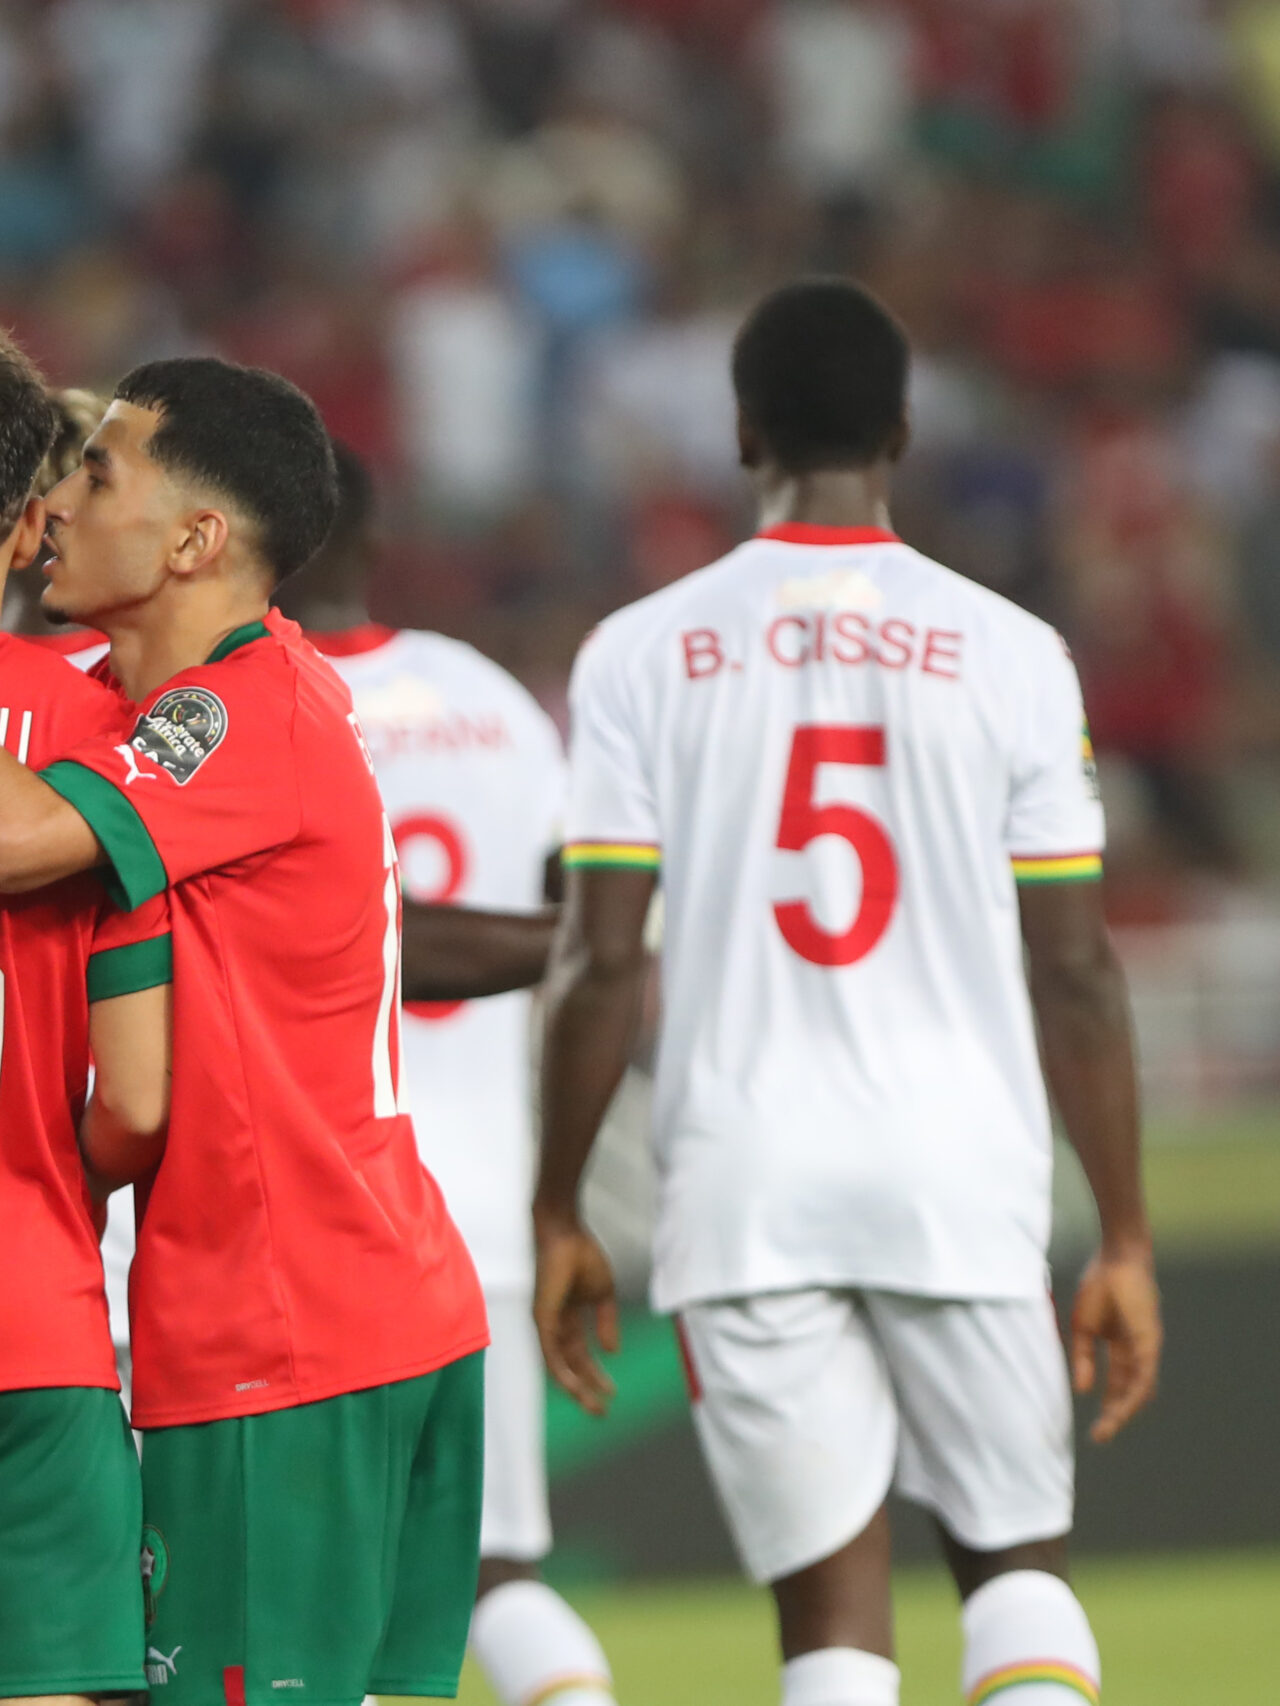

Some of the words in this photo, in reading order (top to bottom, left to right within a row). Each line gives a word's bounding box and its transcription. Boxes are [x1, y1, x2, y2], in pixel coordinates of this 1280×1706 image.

[681, 629, 743, 680] B.
[766, 612, 962, 679] CISSE
[772, 723, 901, 967] 5
[271, 1678, 305, 1689] DRYCELL
